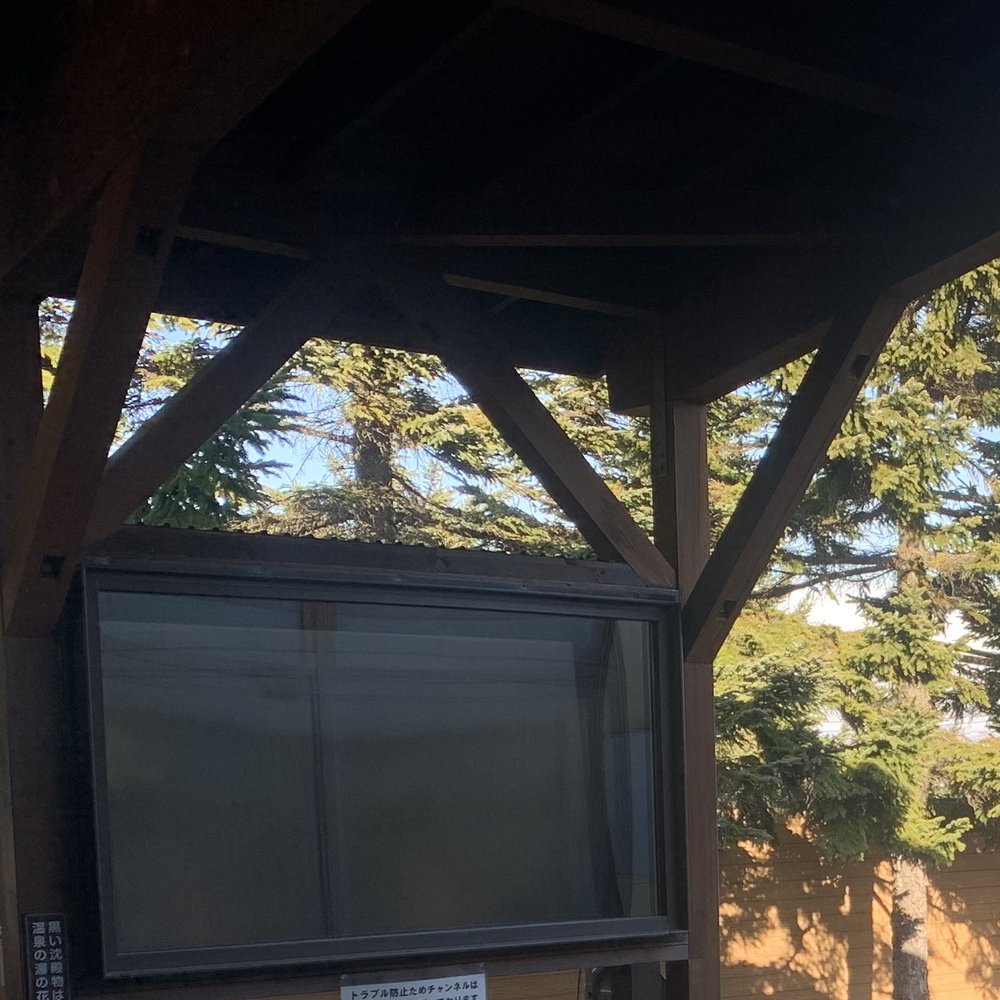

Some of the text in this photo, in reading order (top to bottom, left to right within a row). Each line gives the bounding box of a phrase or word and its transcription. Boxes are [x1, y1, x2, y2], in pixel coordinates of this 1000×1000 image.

[351, 980, 478, 1000] トラブル防止ためチャンネルは
